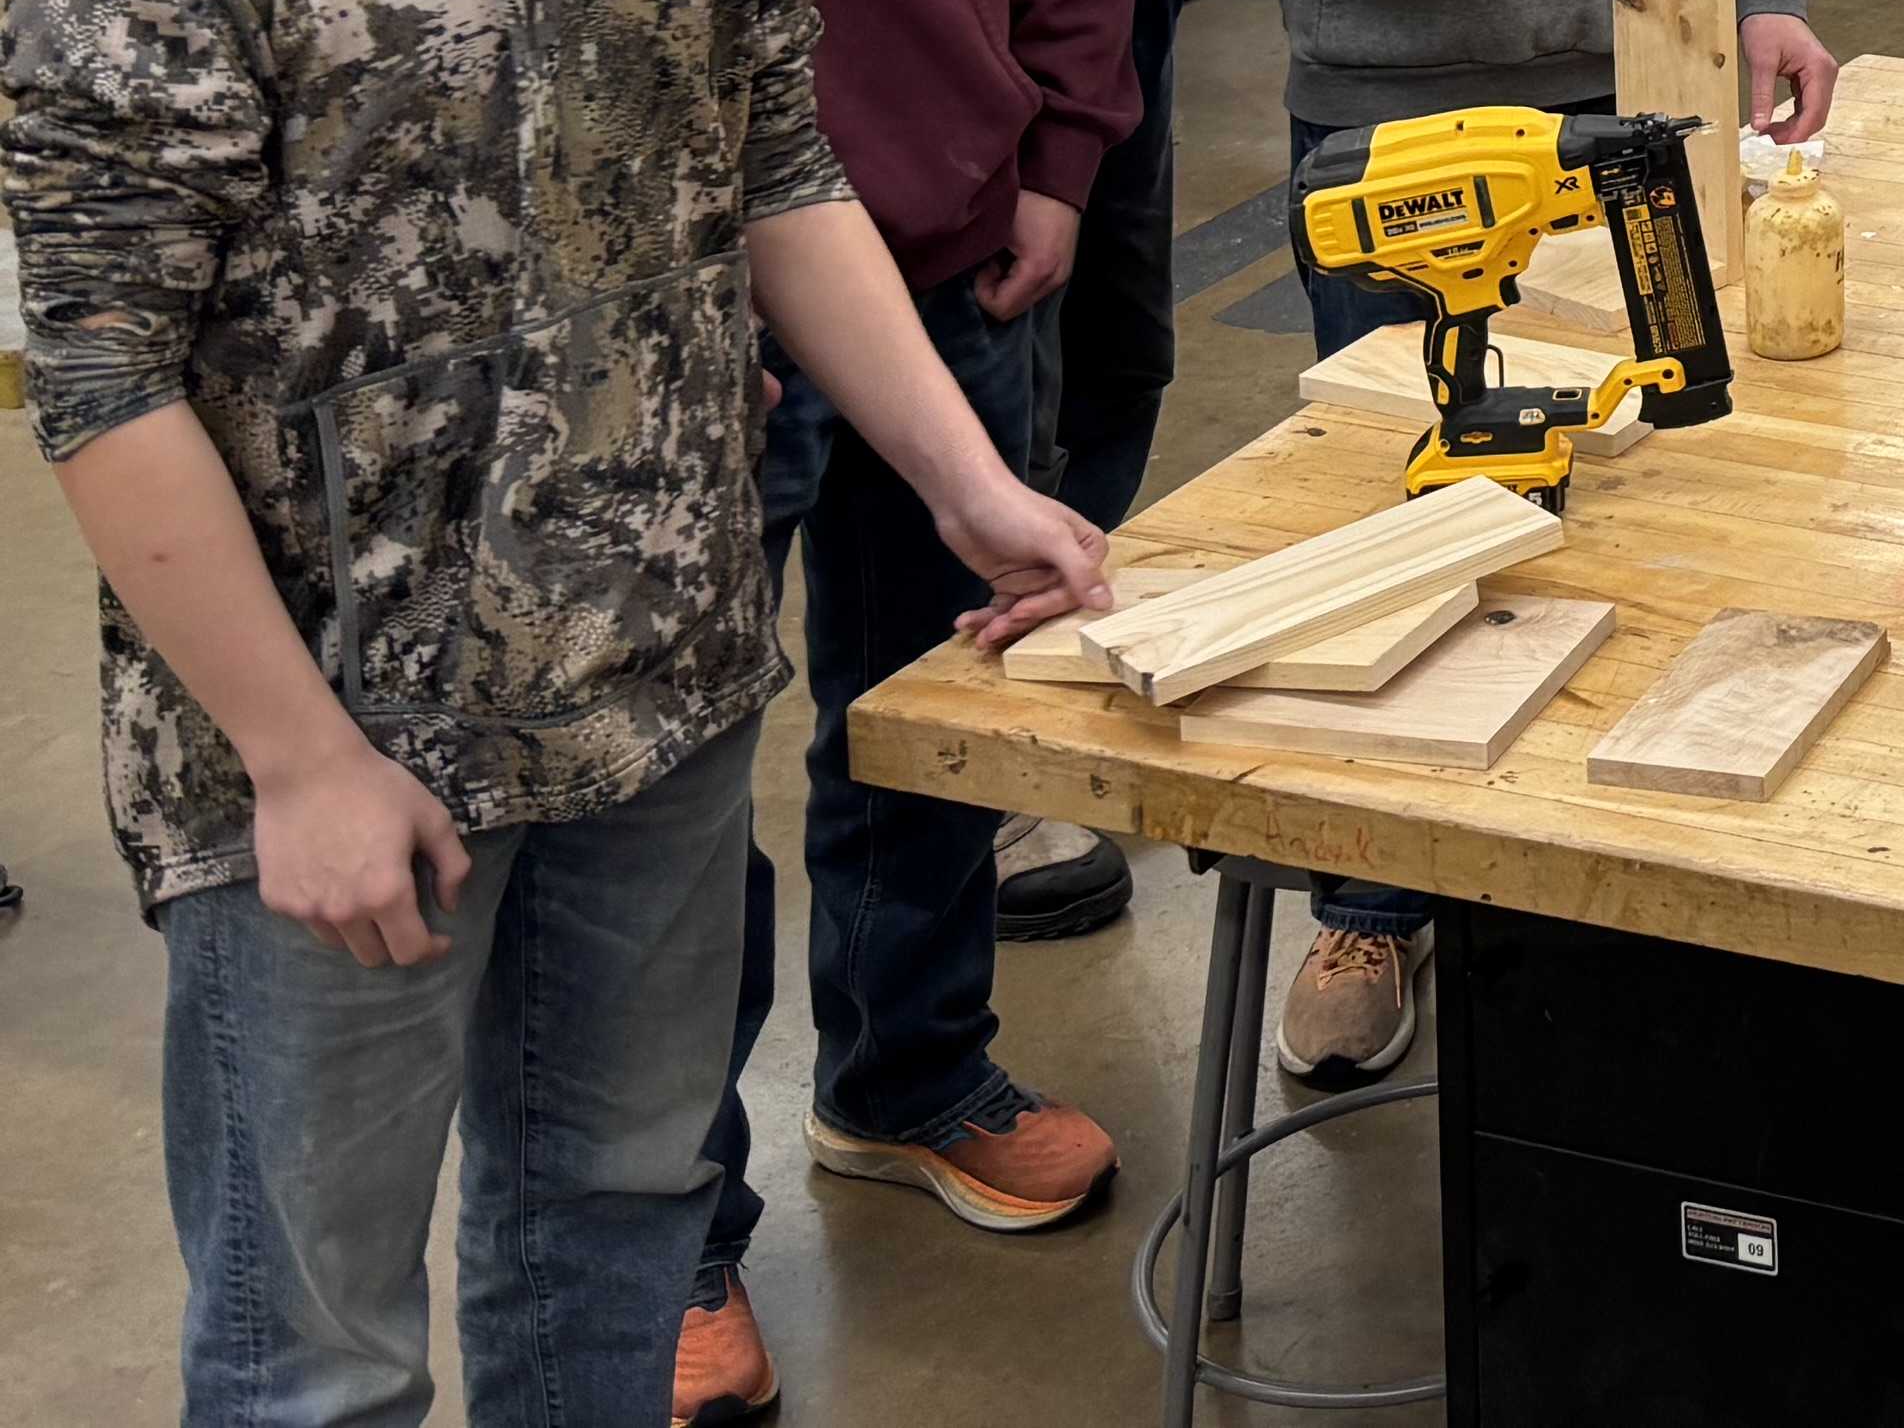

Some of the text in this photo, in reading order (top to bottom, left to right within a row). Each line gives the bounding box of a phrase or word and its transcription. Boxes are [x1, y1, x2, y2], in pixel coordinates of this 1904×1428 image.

[1555, 176, 1580, 194] XR
[1378, 190, 1464, 220] DEWALT
[1748, 1242, 1764, 1257] 09
